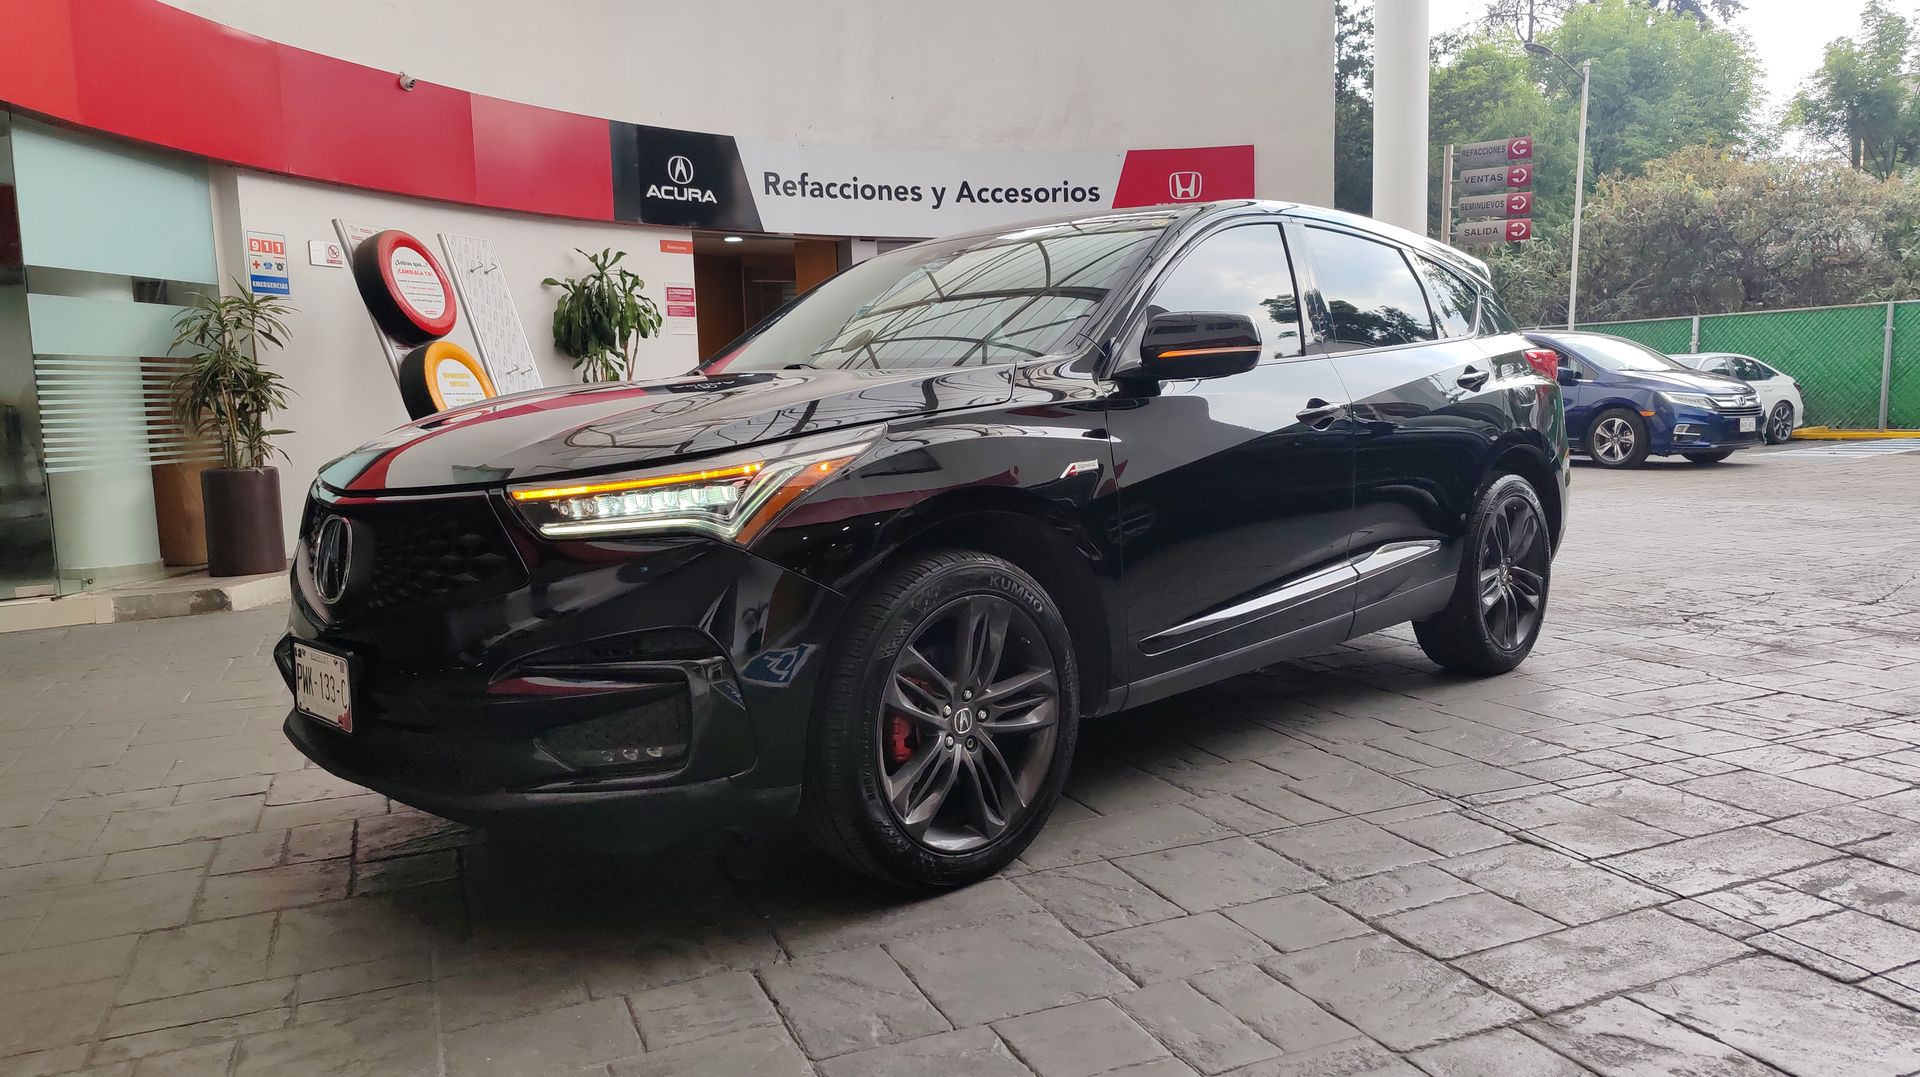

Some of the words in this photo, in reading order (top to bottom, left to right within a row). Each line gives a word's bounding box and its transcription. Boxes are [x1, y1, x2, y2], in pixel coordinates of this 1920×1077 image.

[1461, 145, 1506, 157] REFACCIONES
[1464, 173, 1503, 184] VENTAS
[645, 184, 718, 204] ACURA
[763, 171, 923, 202] Refacciones
[930, 185, 947, 210] y
[955, 180, 1101, 204] Accesorios
[1460, 200, 1505, 211] SEMINUEVOS
[1463, 227, 1499, 237] SALIDA
[250, 240, 282, 254] 911
[252, 280, 288, 290] EMERGENCIAS
[989, 575, 1043, 613] KUMHO
